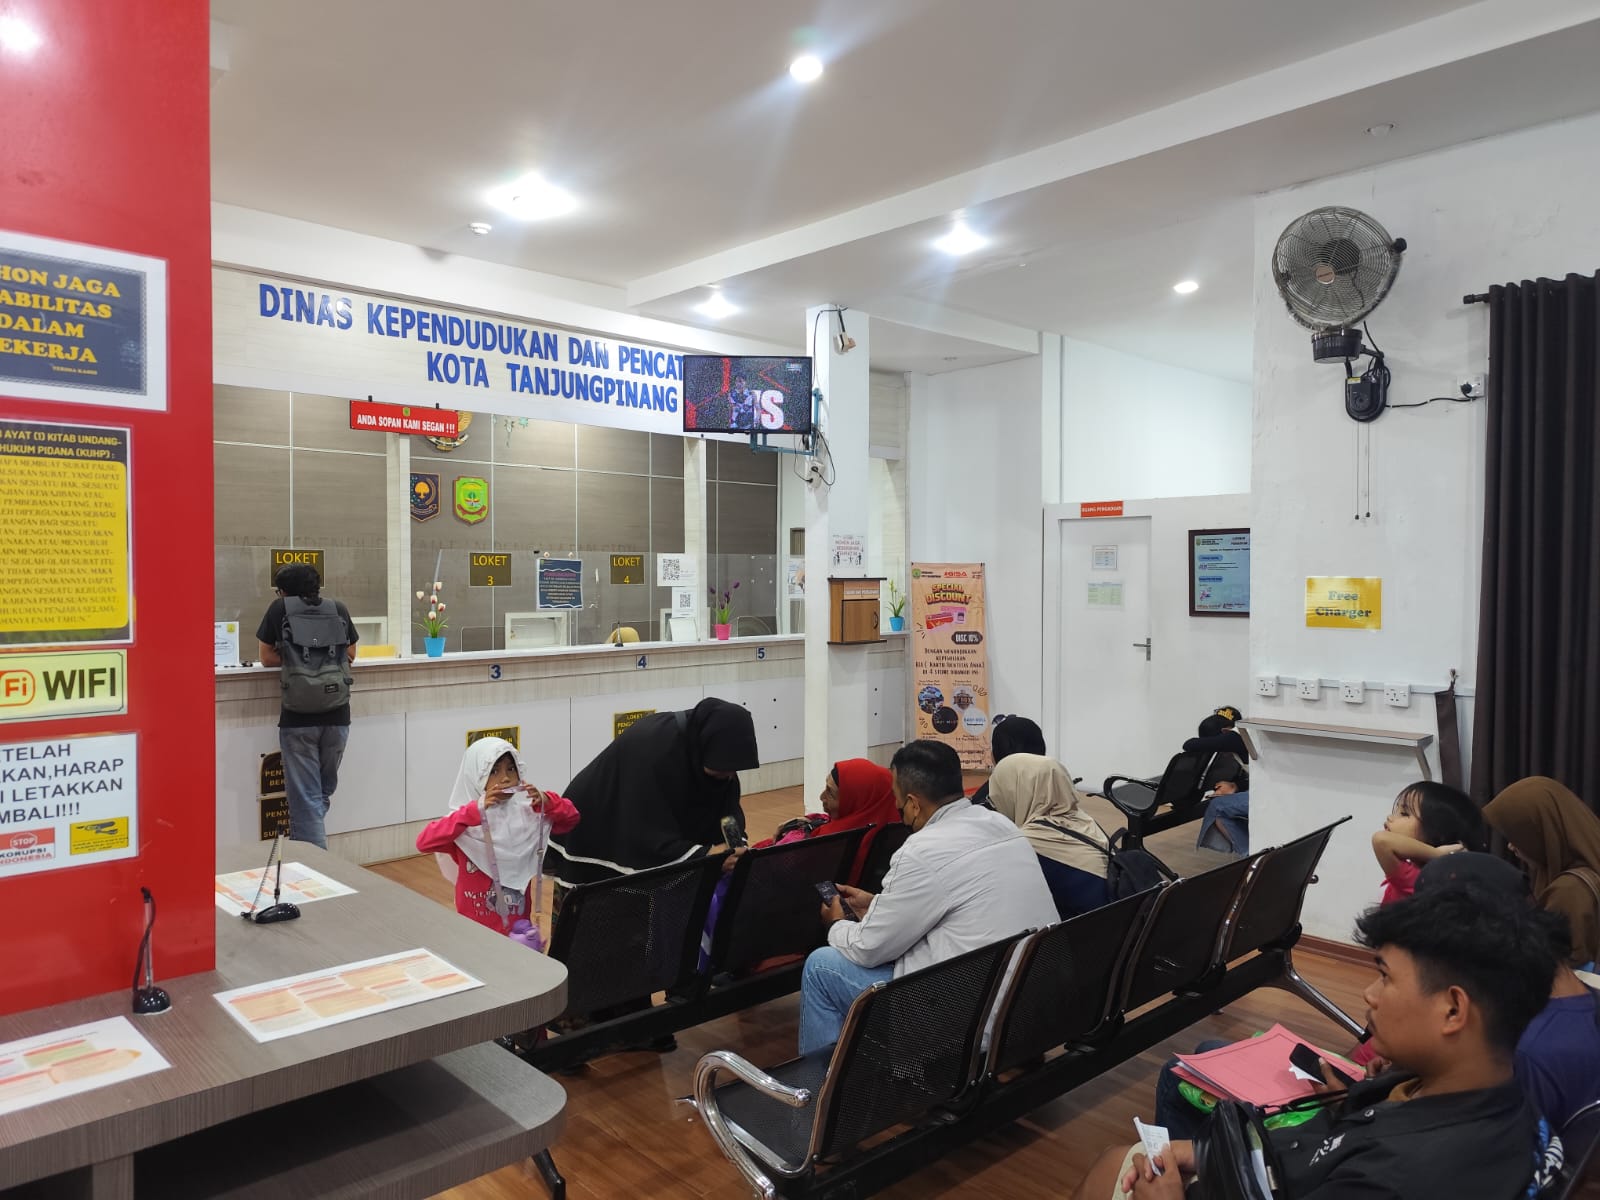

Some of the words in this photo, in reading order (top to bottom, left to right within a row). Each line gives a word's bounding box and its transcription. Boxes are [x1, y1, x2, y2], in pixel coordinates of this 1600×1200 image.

[0, 265, 48, 286] HON
[53, 274, 120, 298] JAGA
[0, 289, 112, 318] ABILITAS
[0, 313, 84, 338] DALAM
[259, 283, 353, 330] DINAS
[367, 302, 558, 361] KEPENDUDUKAN
[568, 336, 609, 369] DAN
[619, 345, 684, 381] PENCAT
[0, 337, 97, 363] EKERJA
[427, 351, 489, 388] KOTA
[507, 363, 677, 413] TANJUNGPINANG
[357, 414, 377, 426] ANDA
[378, 416, 402, 428] SOPAN
[403, 419, 420, 430] KAMI
[422, 420, 444, 433] SEGAN
[446, 423, 455, 434] !!!
[4, 430, 32, 440] AYAT
[47, 433, 77, 443] KITAB
[78, 435, 122, 446] UNDANG-
[0, 444, 35, 454] HUKUM
[38, 446, 74, 456] PIDANA
[76, 448, 110, 459] (KUHP)
[276, 552, 319, 564] LOKET
[473, 555, 507, 566] LOKET
[613, 556, 641, 567] LOKET
[487, 575, 494, 586] 3
[623, 575, 630, 584] 4
[931, 583, 964, 593] SPECIAL
[1328, 590, 1358, 601] Free
[926, 592, 972, 604] DISCOUNT
[1315, 606, 1372, 620] Charger
[756, 648, 765, 660] 5
[637, 656, 647, 669] 4
[490, 664, 502, 679] 3
[5, 677, 27, 697] Fi
[42, 667, 116, 701] WIFI
[2, 743, 71, 762] TELAH
[12, 778, 122, 802] LETAKKAN
[0, 802, 80, 824] MBALI!!!
[0, 846, 47, 859] KORUPSI
